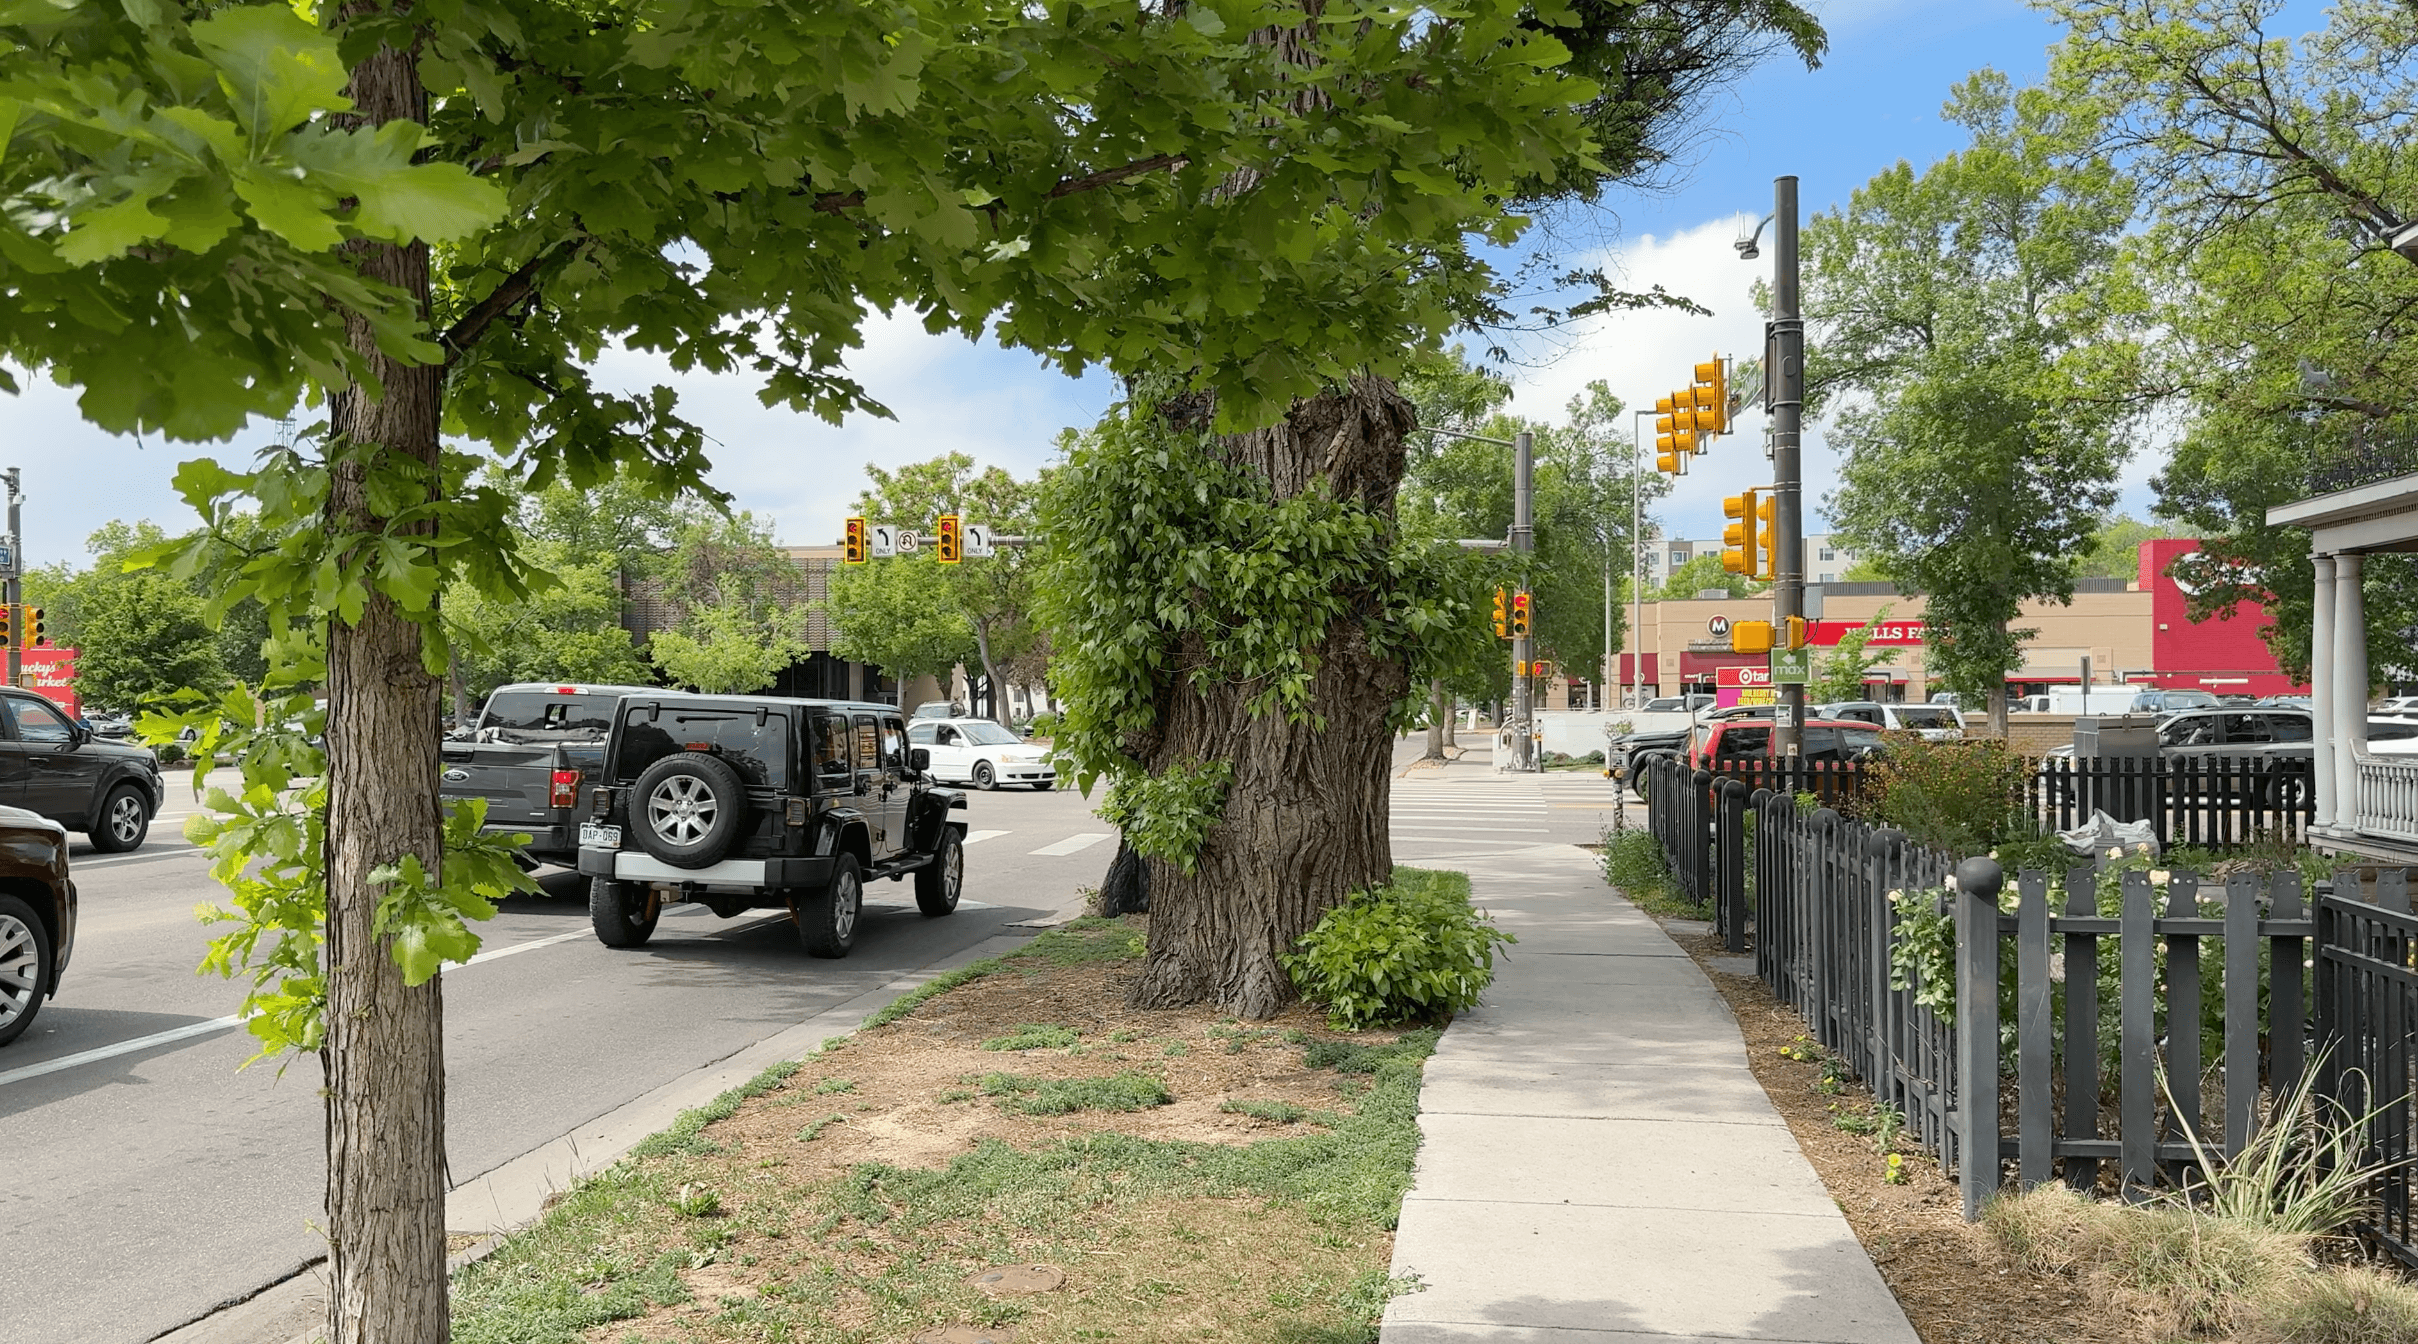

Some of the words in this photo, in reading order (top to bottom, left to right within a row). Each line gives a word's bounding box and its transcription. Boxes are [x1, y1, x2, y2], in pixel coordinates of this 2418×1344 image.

[875, 547, 890, 555] ONLY
[967, 547, 982, 555] ONLY
[1711, 619, 1726, 632] M
[1774, 665, 1806, 675] max
